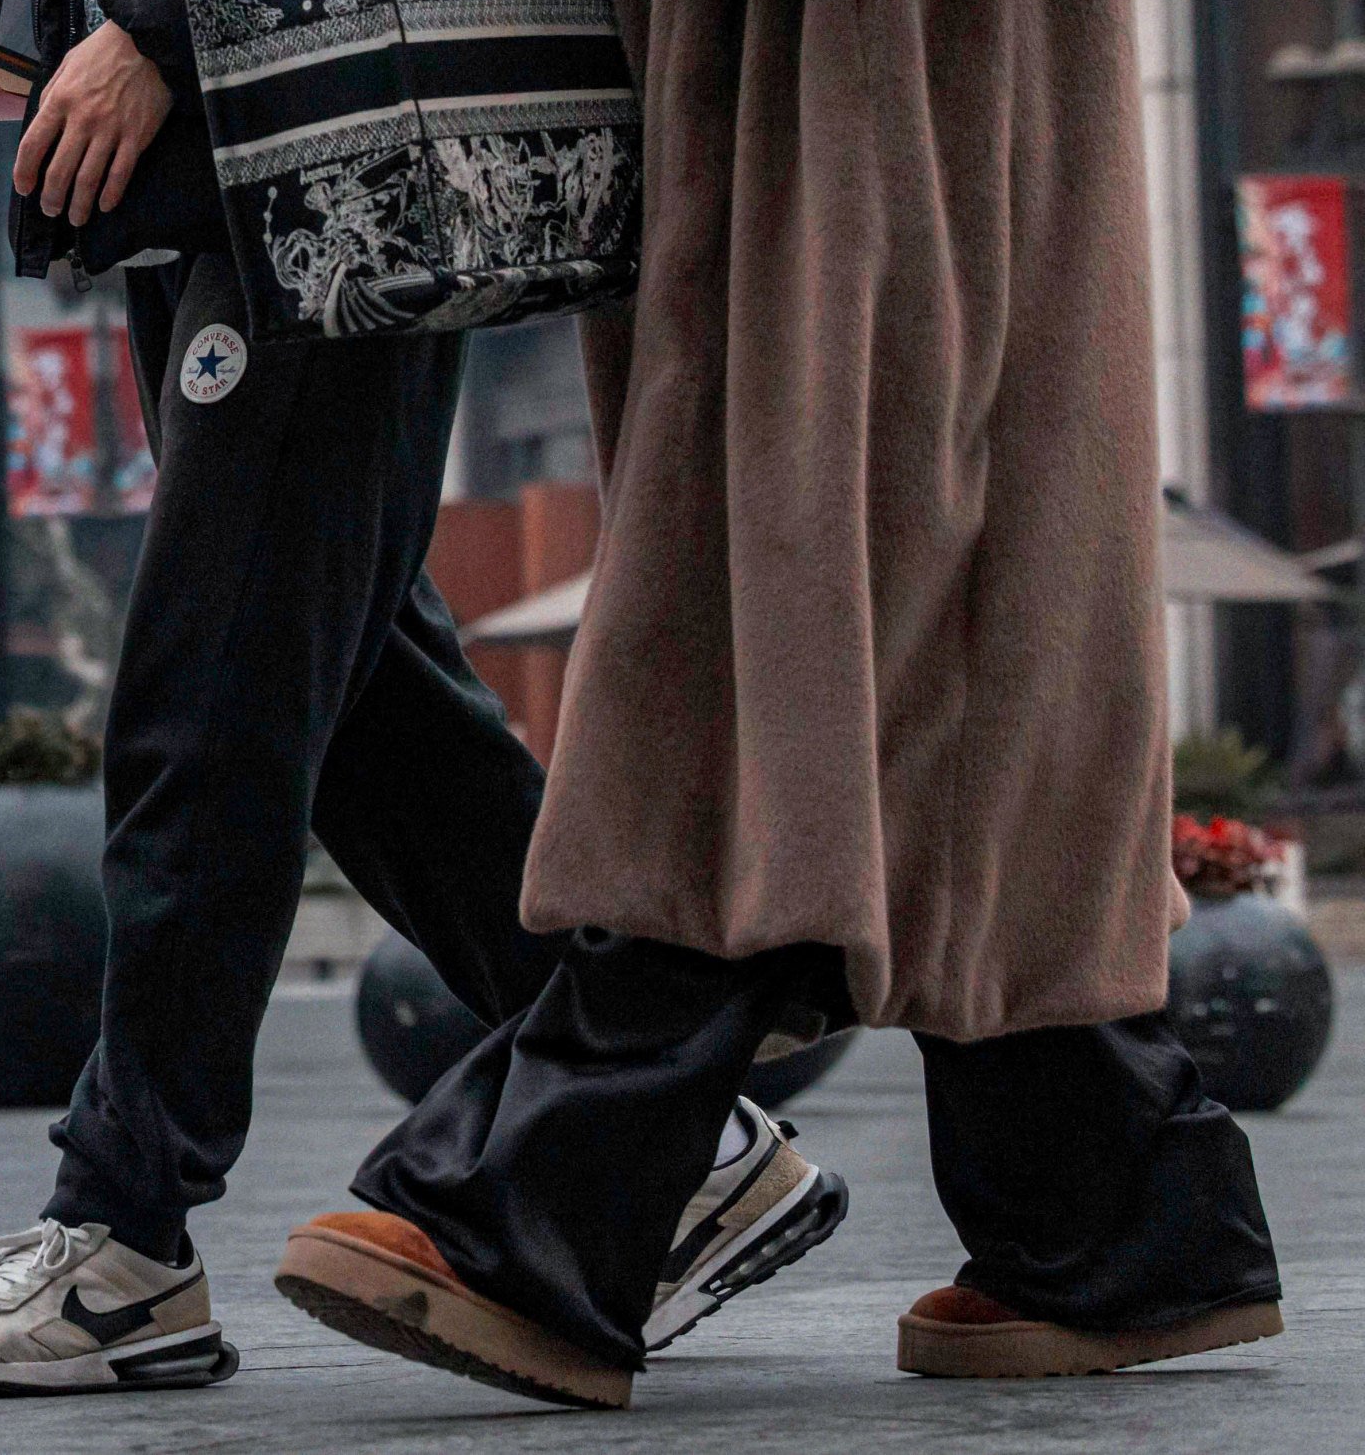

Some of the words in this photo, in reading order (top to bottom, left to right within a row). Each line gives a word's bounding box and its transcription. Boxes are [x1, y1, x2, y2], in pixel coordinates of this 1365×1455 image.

[192, 332, 240, 355] CONVERSE
[187, 379, 198, 394] ALL
[202, 378, 228, 395] STAR
